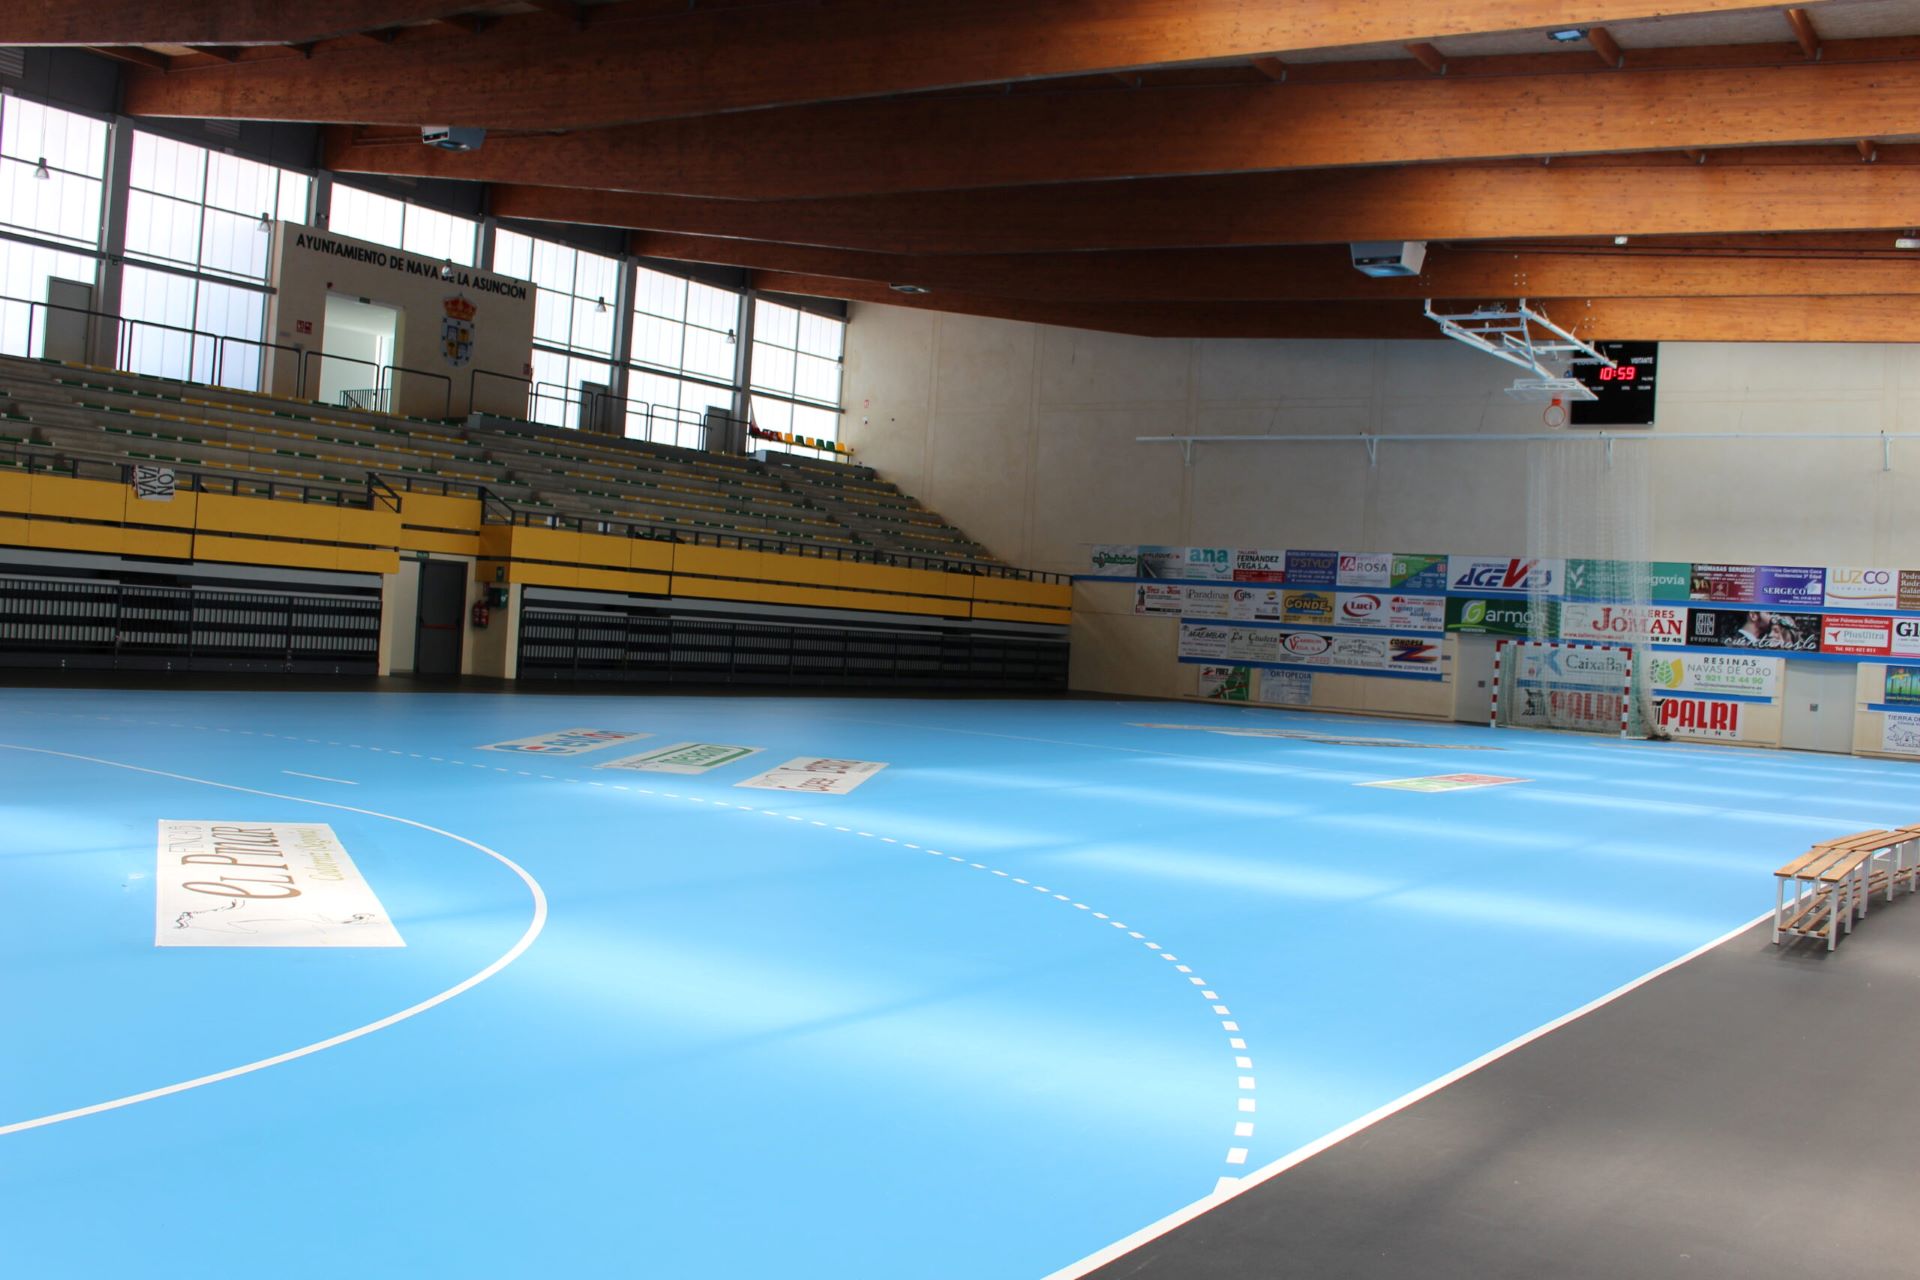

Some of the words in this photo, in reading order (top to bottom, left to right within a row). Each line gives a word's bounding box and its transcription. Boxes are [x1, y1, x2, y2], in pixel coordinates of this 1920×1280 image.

[296, 234, 387, 266] AYUNTAMIENTO
[390, 257, 404, 271] DE
[406, 260, 439, 280] NAVA
[457, 271, 470, 287] LA
[472, 277, 526, 300] ASUNCIÓN
[1600, 367, 1636, 380] 10:59
[158, 466, 174, 496] ON
[1190, 548, 1228, 563] ana
[1357, 563, 1387, 572] ROSA
[1832, 569, 1889, 585] LUZCO
[1763, 587, 1806, 595] SERGECO
[1351, 601, 1373, 611] Luci
[1621, 608, 1675, 618] TALLERES
[1592, 607, 1683, 635] JOMAN
[1843, 630, 1885, 640] PlusUltra
[1896, 621, 1920, 637] Gl
[1566, 654, 1626, 670] CaixaBa
[1704, 656, 1757, 666] RESINAS
[1270, 670, 1312, 681] ORTOPEDIA
[1687, 663, 1721, 674] NAVAS
[1727, 665, 1741, 674] DE
[1746, 666, 1771, 677] ORO
[1705, 674, 1720, 682] 921
[1726, 675, 1736, 683] 12
[1550, 691, 1622, 722] PALRI
[1660, 698, 1738, 731] PALRI
[1660, 726, 1736, 738] GAMING
